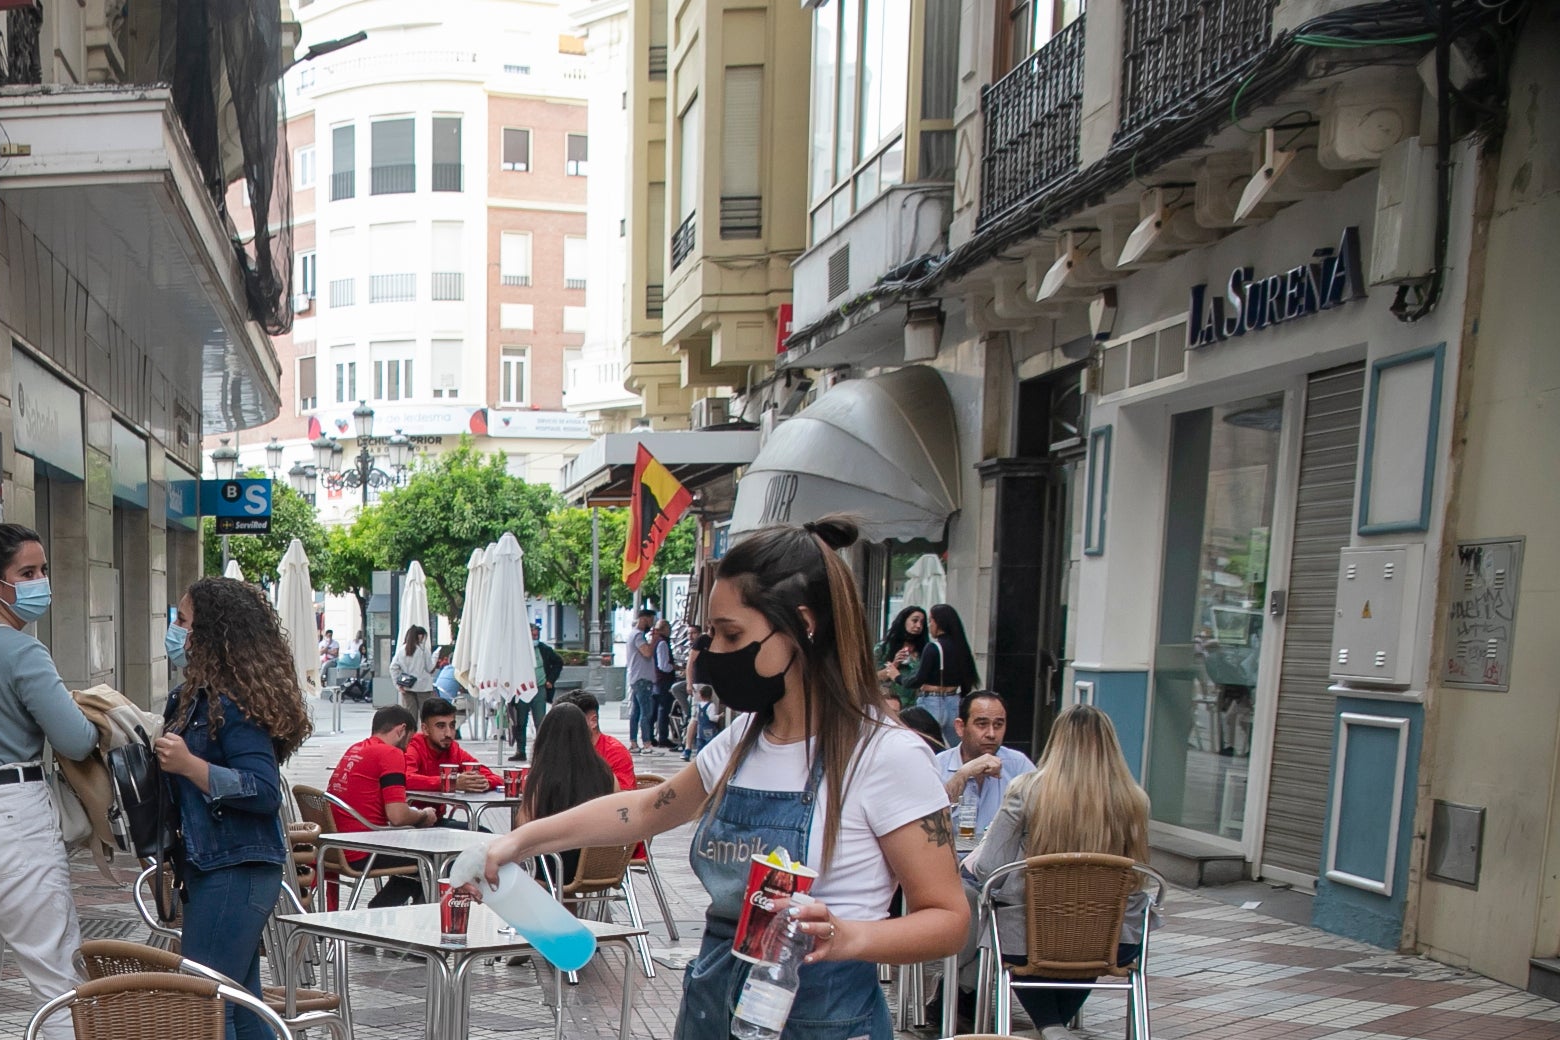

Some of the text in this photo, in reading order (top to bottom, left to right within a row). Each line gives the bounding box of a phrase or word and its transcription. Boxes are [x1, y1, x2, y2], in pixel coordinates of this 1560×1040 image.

[409, 436, 443, 445] PRIOR
[227, 484, 268, 515] B S
[675, 586, 689, 596] AL
[697, 833, 769, 864] Lambik
